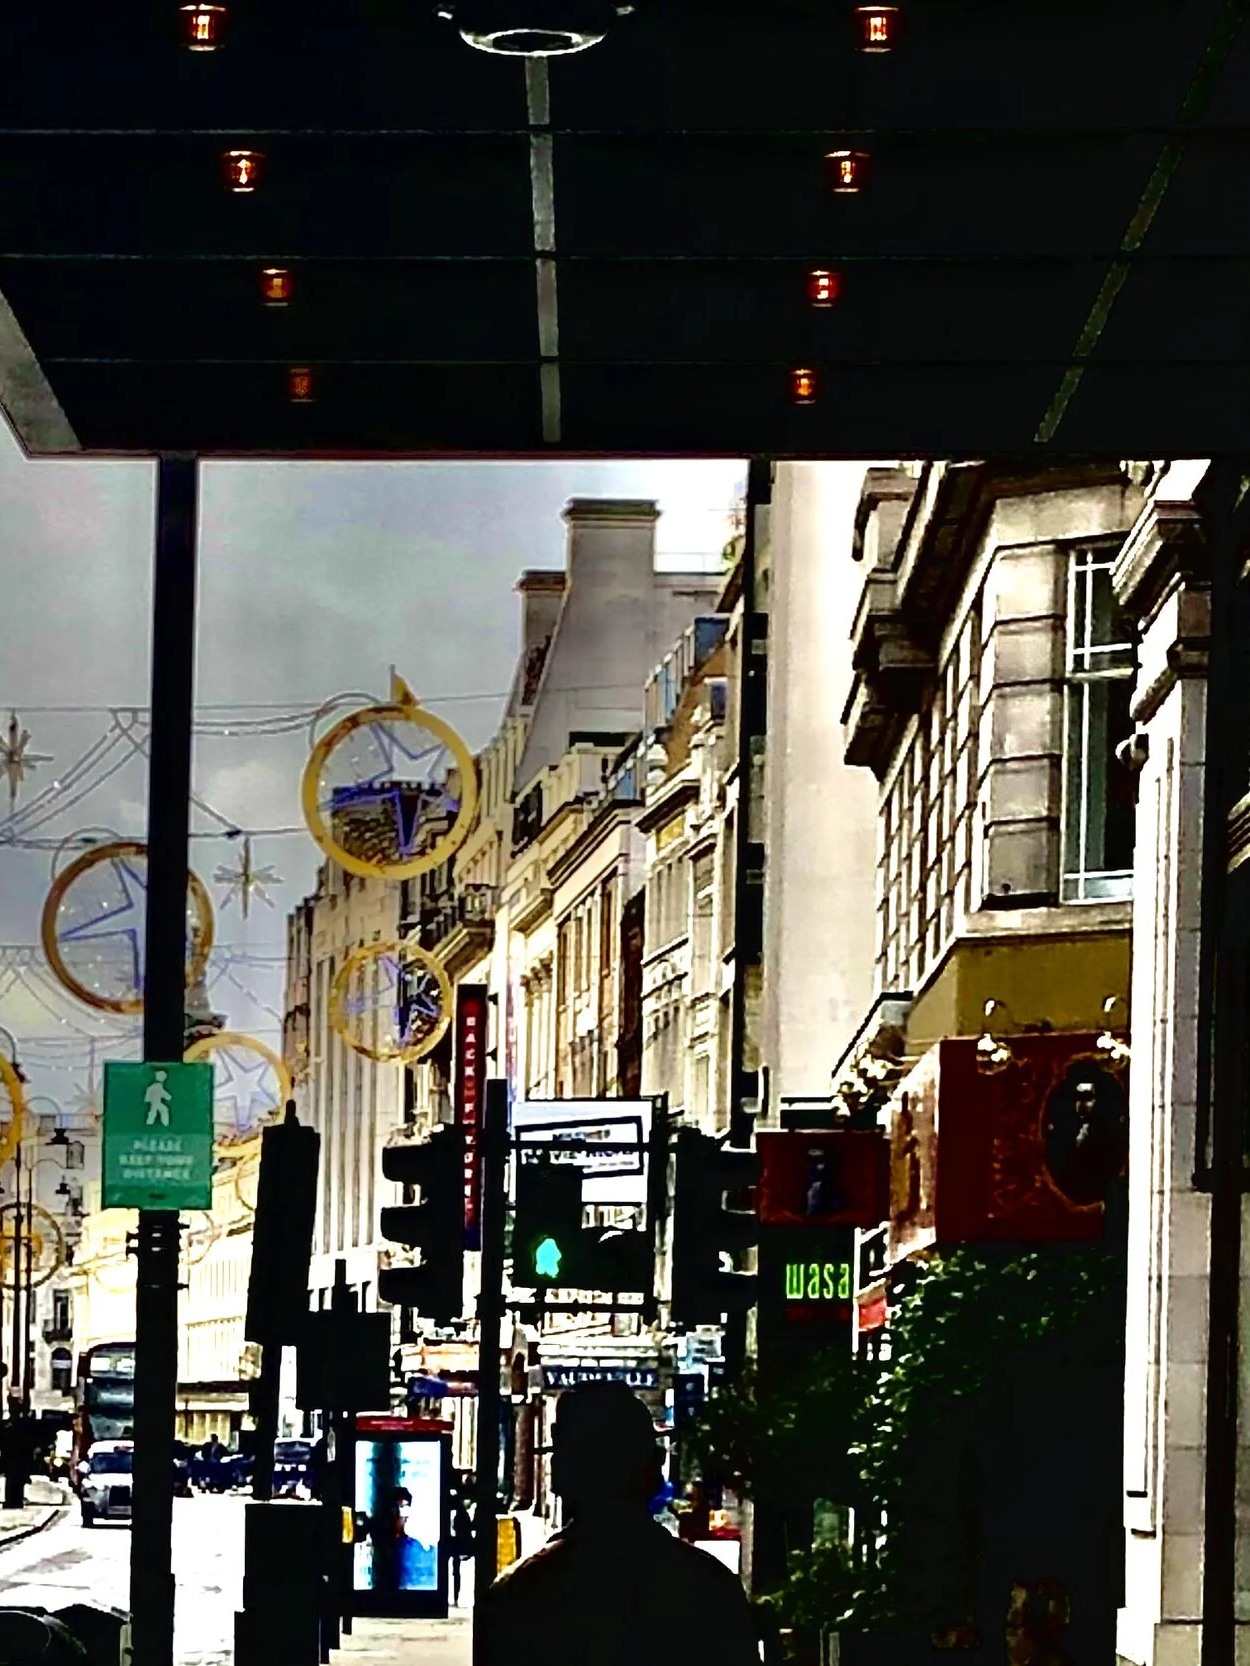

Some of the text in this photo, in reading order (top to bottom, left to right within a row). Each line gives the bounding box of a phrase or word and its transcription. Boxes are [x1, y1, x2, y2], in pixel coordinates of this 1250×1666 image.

[133, 1139, 182, 1151] PLEASE
[119, 1154, 152, 1166] KEEP
[123, 1168, 191, 1180] DISTANCE
